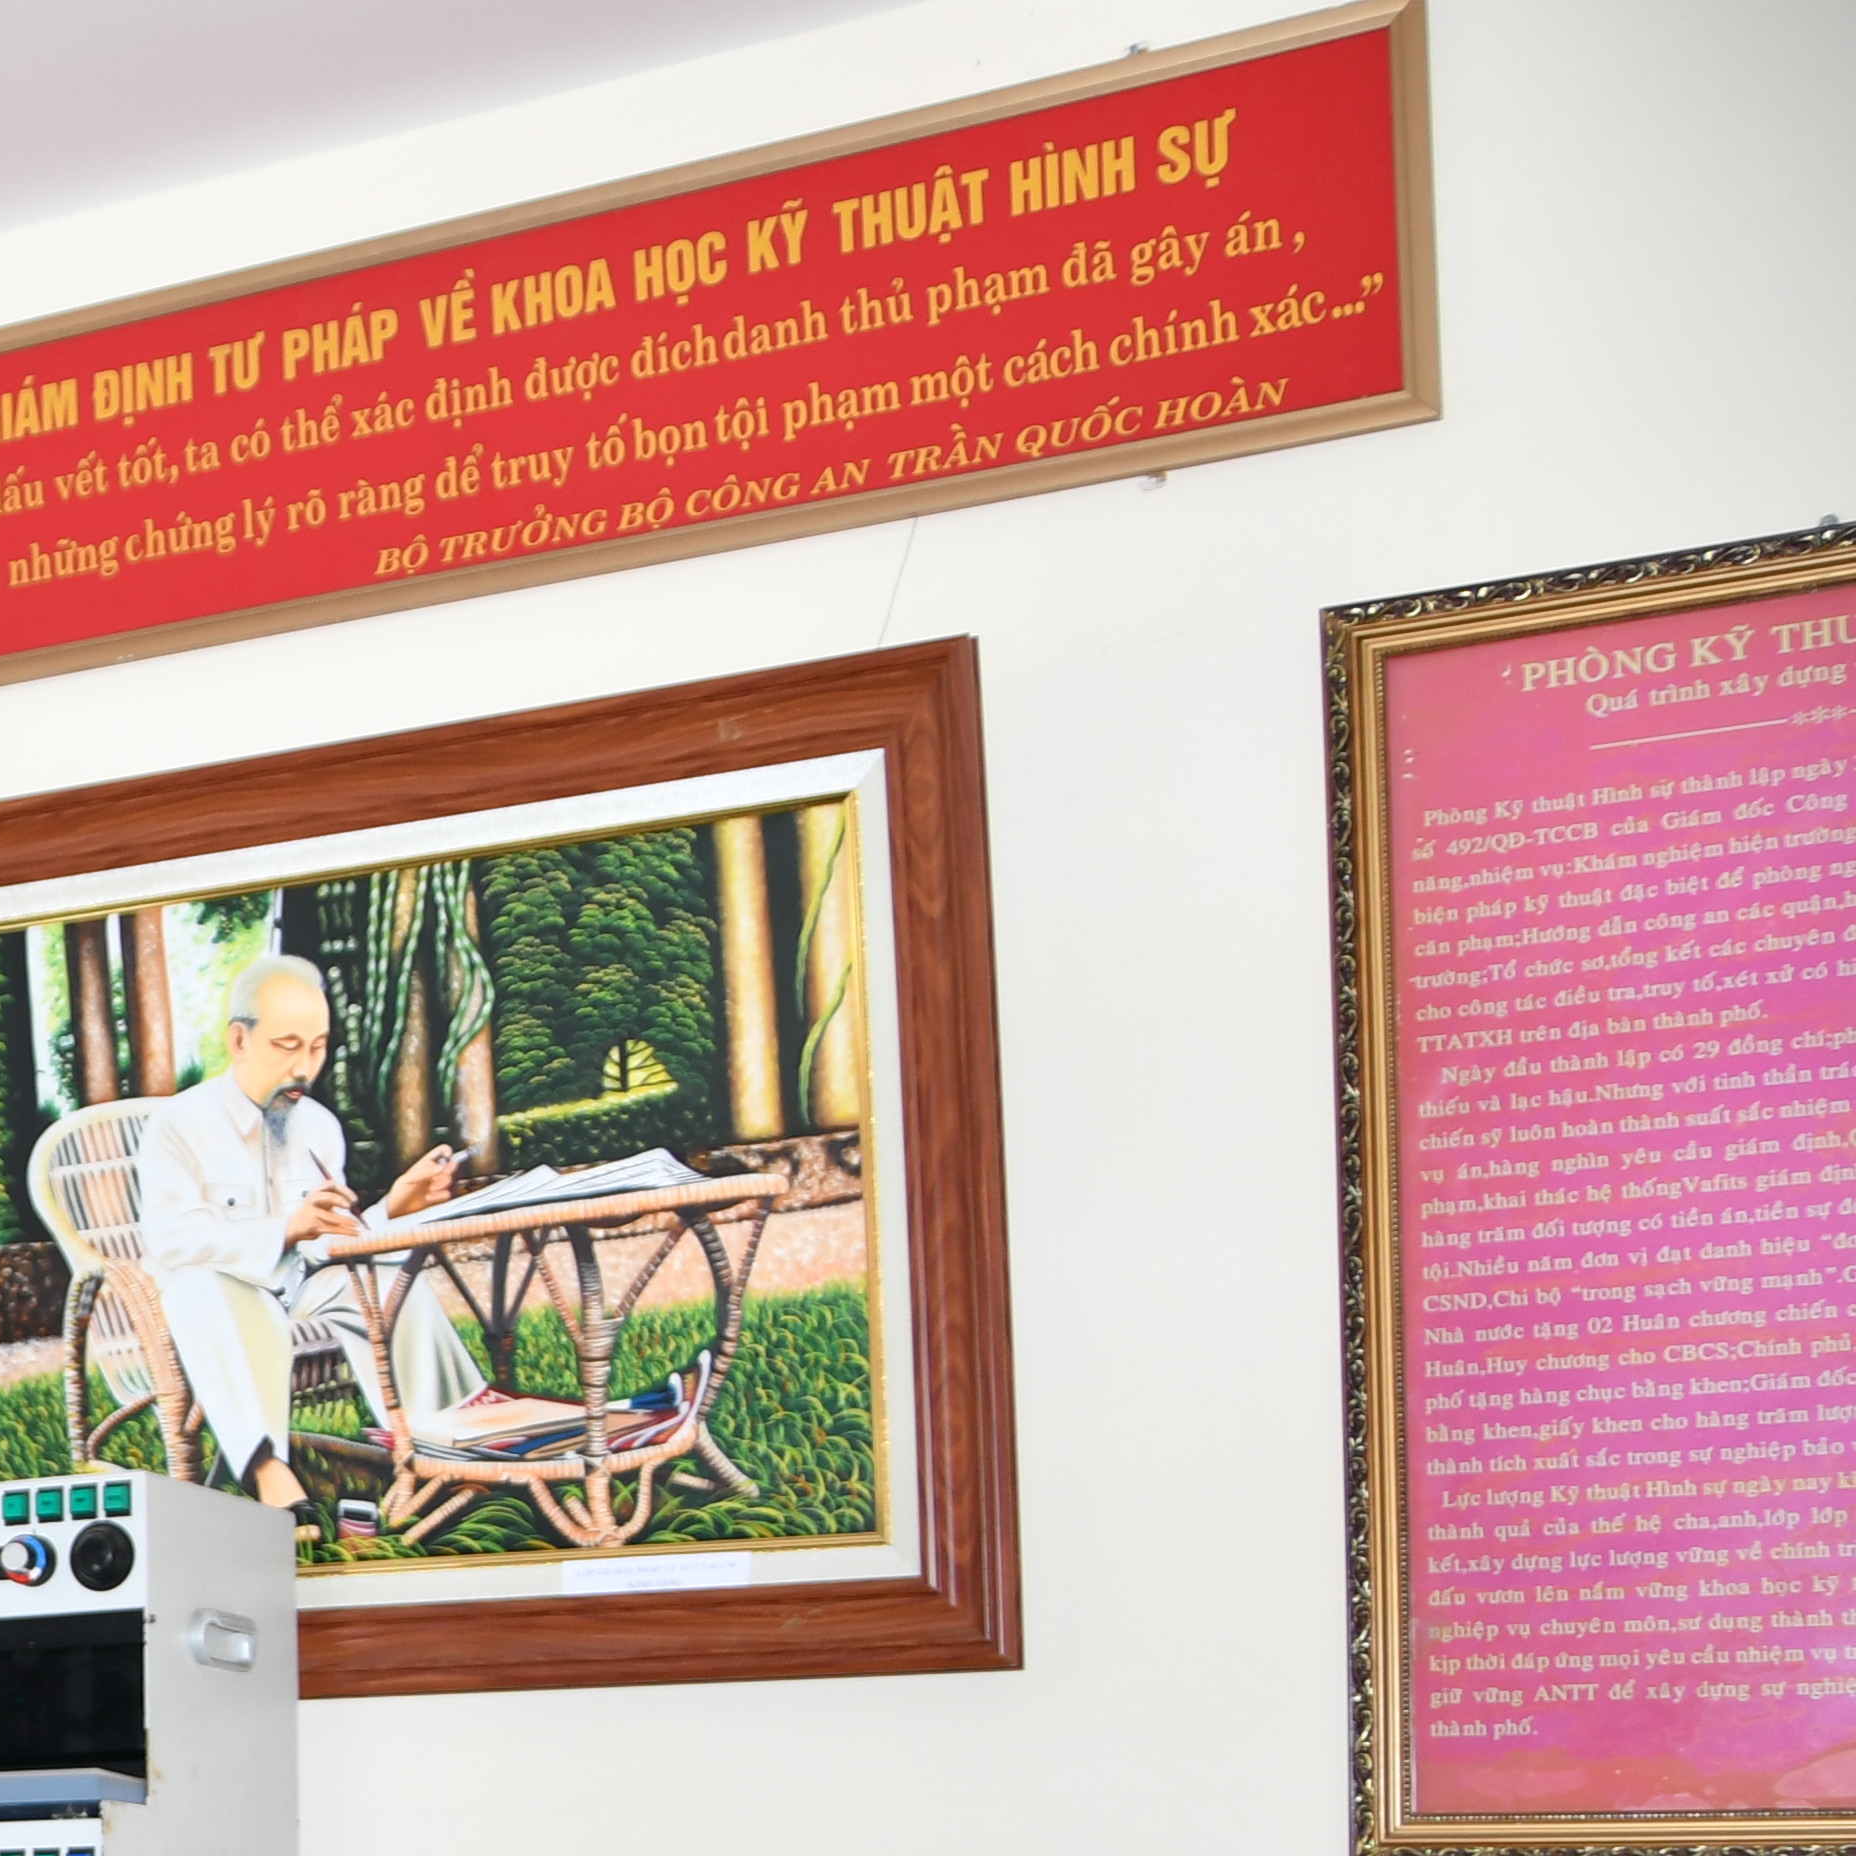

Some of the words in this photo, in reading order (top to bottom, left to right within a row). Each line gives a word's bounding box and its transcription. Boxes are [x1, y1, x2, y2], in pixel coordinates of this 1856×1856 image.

[93, 353, 193, 426] ĐỊNH
[209, 332, 264, 394] TƯ
[283, 302, 398, 380] PHÁP
[420, 269, 476, 348] VỀ
[492, 259, 616, 335] KHOA
[634, 232, 727, 305] HỌC
[748, 199, 807, 273] KỸ
[833, 166, 988, 253] THUẬT
[1011, 137, 1135, 216] HÌNH
[1158, 109, 1235, 187] SỰ
[55, 451, 107, 499] vết
[185, 440, 220, 472] ta
[231, 419, 270, 462] có
[281, 395, 342, 451] thể
[352, 392, 413, 437] xác
[426, 367, 513, 427] định
[525, 353, 618, 400] được
[632, 324, 718, 378] đích
[724, 301, 828, 360] danh
[840, 278, 913, 334] thủ
[928, 265, 1049, 325] phạm
[1063, 242, 1116, 287] đã
[1132, 226, 1209, 285] gây
[10, 537, 118, 586] những
[126, 512, 236, 561] chứng
[243, 497, 275, 546] lý
[288, 490, 326, 530] rõ
[339, 474, 425, 519] ràng
[436, 444, 483, 499] để
[492, 447, 573, 488] truy
[586, 414, 627, 469] tố
[633, 418, 707, 466] bọn
[715, 397, 769, 450] tội
[783, 382, 900, 441] phạm
[911, 354, 993, 407] một
[1004, 329, 1099, 386] cách
[1110, 300, 1239, 365] chính
[375, 535, 428, 574] BỘ
[440, 504, 606, 562] TRƯỞNG
[618, 488, 674, 530] BỘ
[686, 474, 799, 516] CÔNG
[811, 459, 869, 494] AN
[889, 424, 1003, 478] TRẦN
[1017, 397, 1142, 457] QUỐC
[1155, 377, 1288, 428] HOÀN
[1521, 644, 1677, 692] PHÒNG
[1691, 624, 1755, 668] KỸ
[1585, 689, 1639, 718] Quá
[1649, 679, 1711, 706] trình
[1719, 672, 1769, 696] xây
[1777, 662, 1847, 689] dựng
[1424, 807, 1488, 827] Phòng
[1494, 800, 1523, 820] Kỹ
[1532, 793, 1585, 814] thuật
[1592, 784, 1643, 806] Hình
[1650, 779, 1675, 799] sự
[1681, 771, 1743, 795] thành
[1749, 767, 1786, 786] lập
[1791, 757, 1848, 781] ngày
[1786, 792, 1848, 815] Công
[1416, 1028, 1513, 1054] TTATXH
[1441, 1065, 1496, 1086] Ngày
[1693, 1040, 1720, 1059] 29
[1588, 1316, 1613, 1334] 02
[1622, 1313, 1681, 1332] Huân
[1689, 1310, 1767, 1328] chương
[1534, 1683, 1599, 1702] ANTT
[1429, 1720, 1487, 1738] thành
